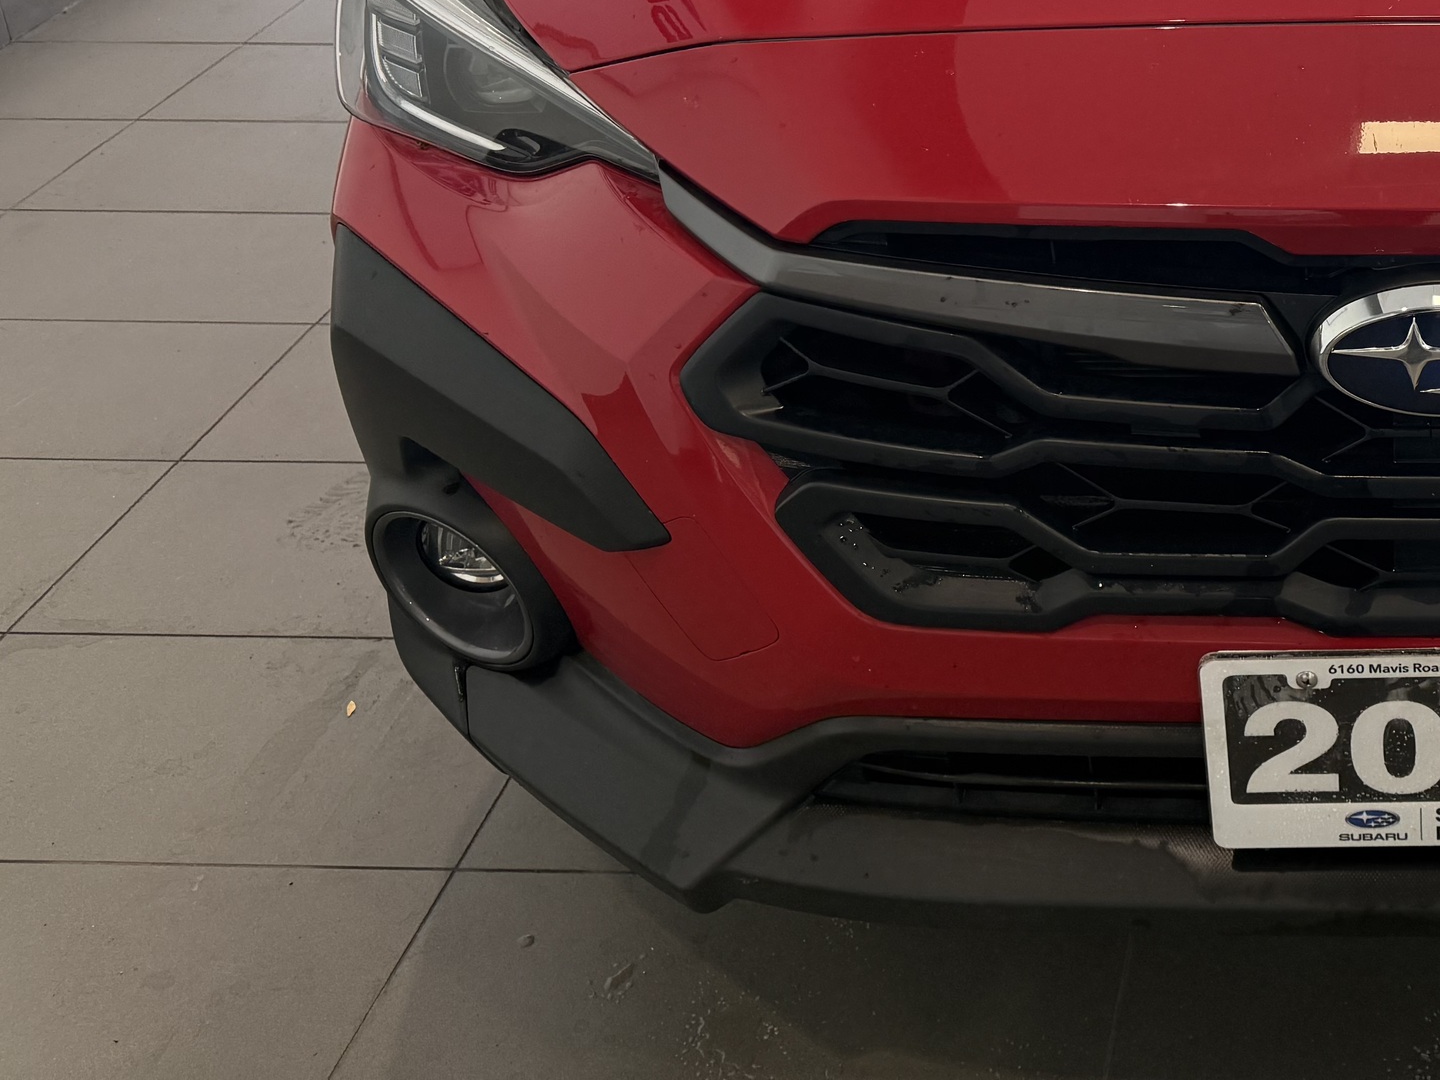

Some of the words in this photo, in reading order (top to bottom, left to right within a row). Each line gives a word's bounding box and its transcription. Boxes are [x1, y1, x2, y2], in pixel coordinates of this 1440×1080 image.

[1328, 664, 1365, 674] 6160
[1369, 663, 1409, 674] Mavis
[1338, 832, 1408, 842] SUBARU
